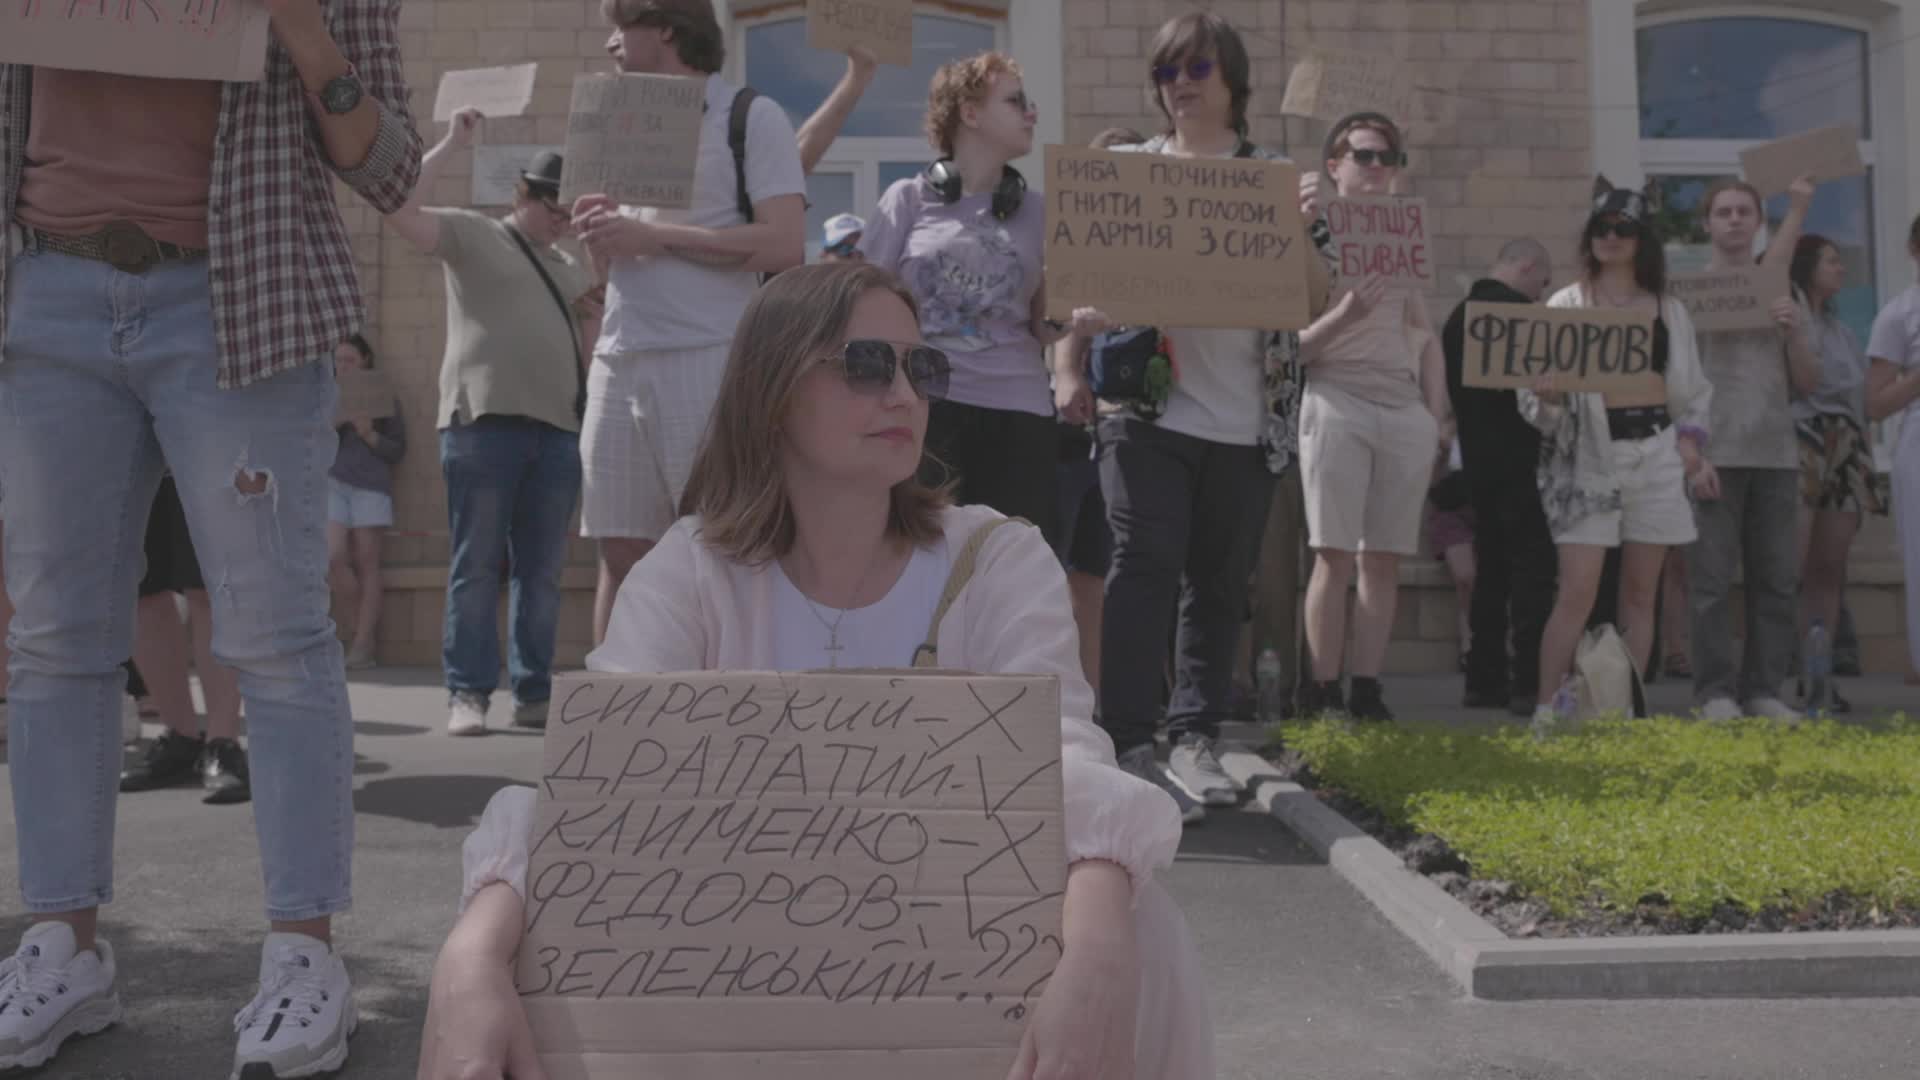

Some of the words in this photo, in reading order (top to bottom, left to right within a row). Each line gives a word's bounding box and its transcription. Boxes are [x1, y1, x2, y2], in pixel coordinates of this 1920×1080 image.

[1056, 158, 1120, 182] РИБА
[1150, 162, 1265, 189] ПОЧИНАЄ
[1057, 190, 1141, 217] ГНИТИ
[1327, 201, 1423, 240] ОРУПЦІЯ
[1053, 220, 1075, 247] А
[1085, 220, 1173, 248] АРМІЯ
[1224, 229, 1293, 260] СИРУ
[1342, 243, 1430, 280] БИВАЄ
[1470, 314, 1649, 377] ФЕДОРОВ
